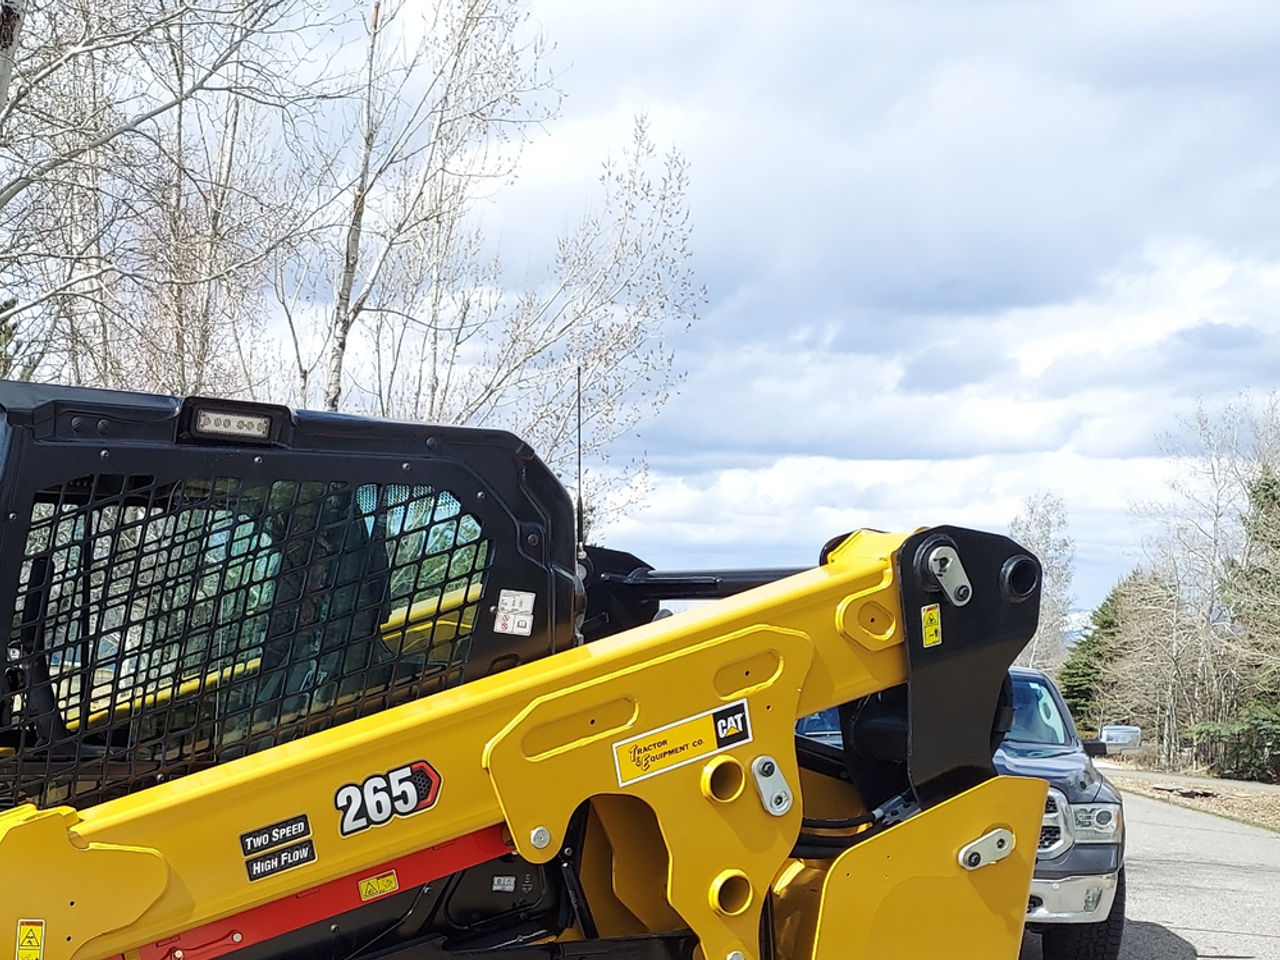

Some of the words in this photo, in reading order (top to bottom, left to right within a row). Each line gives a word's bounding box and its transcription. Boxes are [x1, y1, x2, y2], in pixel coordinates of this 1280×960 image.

[717, 713, 744, 738] CAT
[629, 739, 668, 762] TRACTOR
[642, 743, 690, 771] EQUIPMENT
[336, 766, 419, 834] 265
[245, 833, 269, 850] TWO
[272, 822, 305, 842] SPEED
[253, 857, 278, 876] HIGH
[281, 847, 310, 867] FLOW
